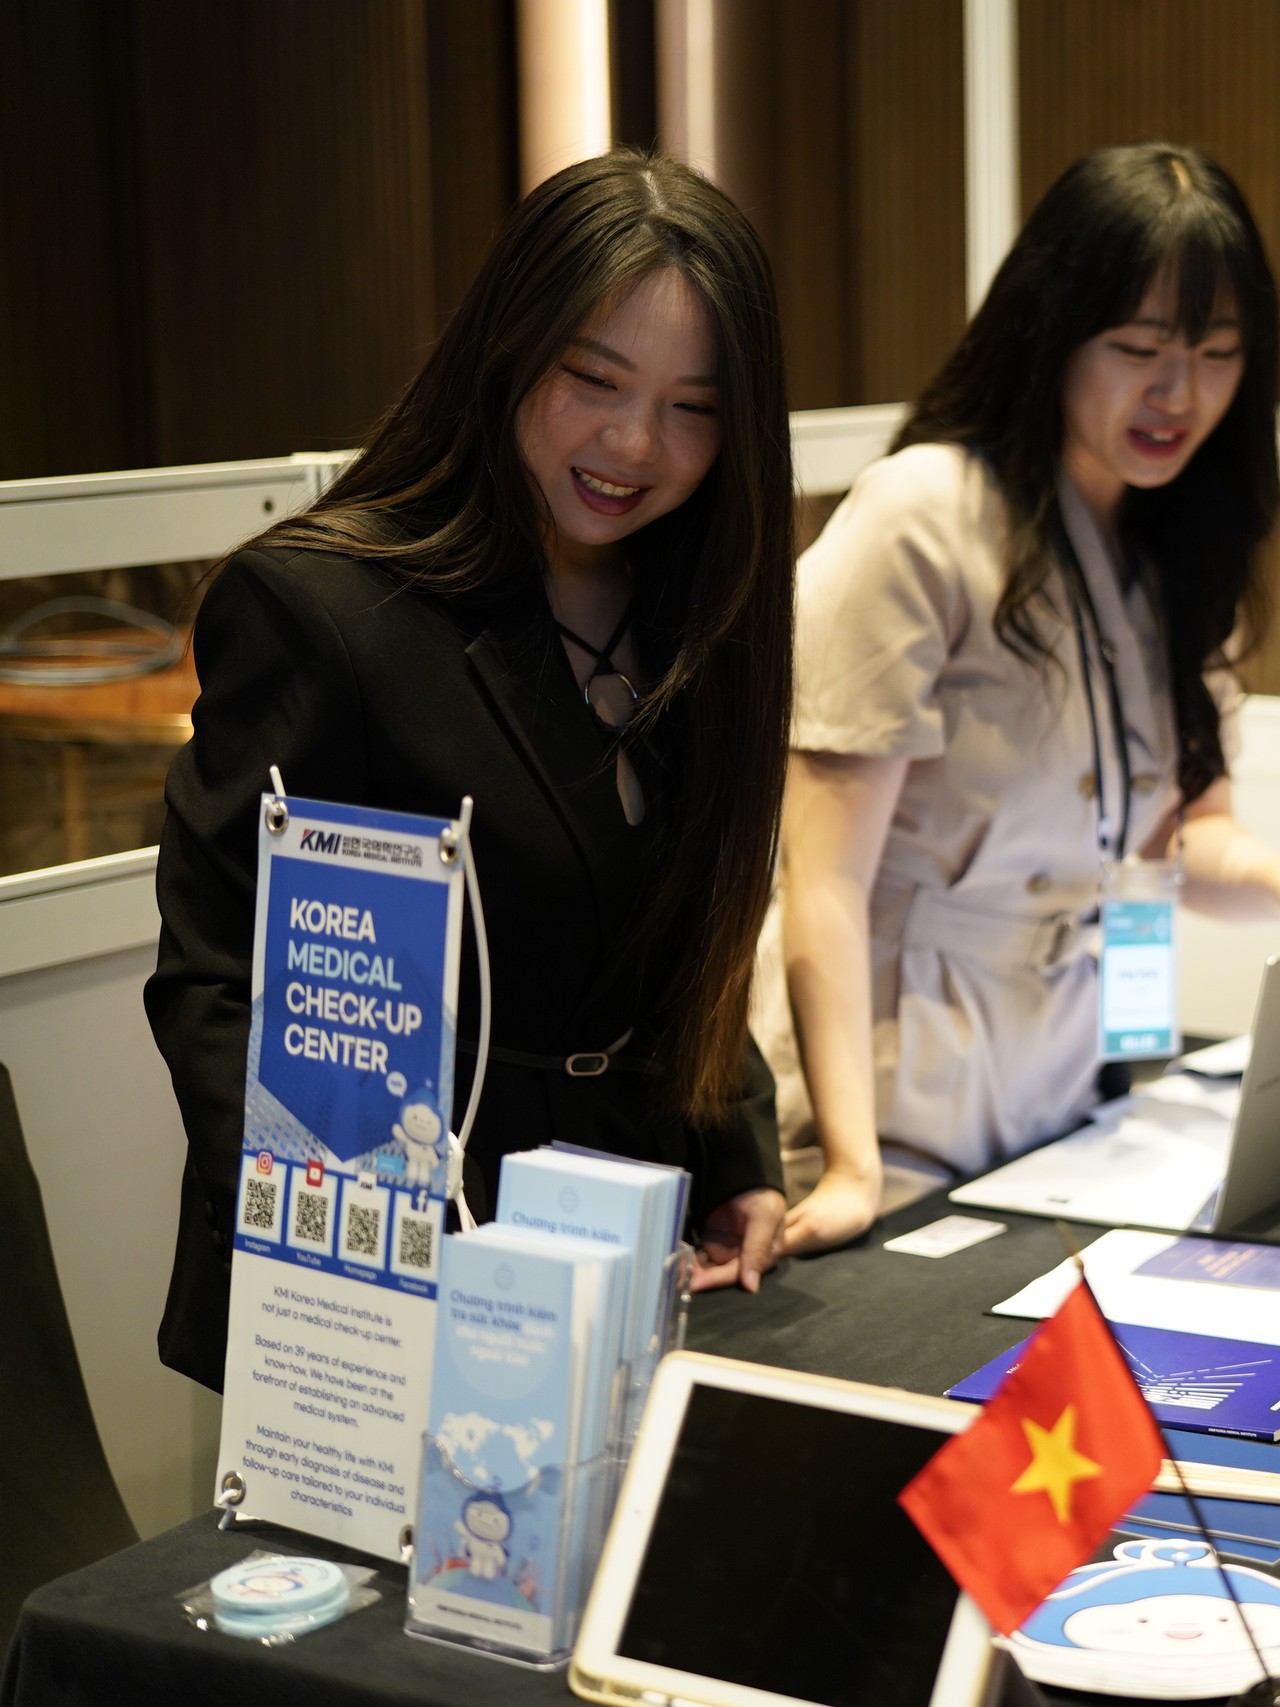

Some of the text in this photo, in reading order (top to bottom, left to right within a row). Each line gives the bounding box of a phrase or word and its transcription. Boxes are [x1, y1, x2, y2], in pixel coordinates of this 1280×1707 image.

[300, 828, 341, 854] KMI
[290, 898, 376, 943] KOREA
[288, 940, 402, 990] MEDICAL
[286, 982, 422, 1036] CHECK-UP
[284, 1024, 388, 1074] CENTER
[296, 1250, 321, 1266] YouTube
[262, 1302, 274, 1312] not
[276, 1306, 291, 1318] just
[292, 1311, 298, 1320] a
[300, 1312, 332, 1328] medical
[334, 1320, 372, 1341] check-up
[274, 1286, 289, 1300] KMI
[291, 1291, 315, 1306] Korea
[317, 1296, 348, 1314] Medical
[351, 1305, 383, 1324] Institute
[255, 1334, 406, 1386] Based on 39 years of experience and
[252, 1369, 404, 1422] forefront of establishing an advanced
[310, 1368, 324, 1380] We
[325, 1372, 345, 1387] have
[346, 1377, 368, 1392] been
[369, 1385, 379, 1396] at
[380, 1388, 394, 1400] the
[294, 1401, 326, 1417] medical
[246, 1440, 405, 1496] through early diagnosis of disease and
[256, 1424, 291, 1444] Maintain
[293, 1436, 310, 1448] your
[312, 1440, 342, 1461] healthy
[344, 1450, 356, 1464] life
[358, 1456, 376, 1468] with
[242, 1455, 406, 1514] follow-up care tailored to your individual
